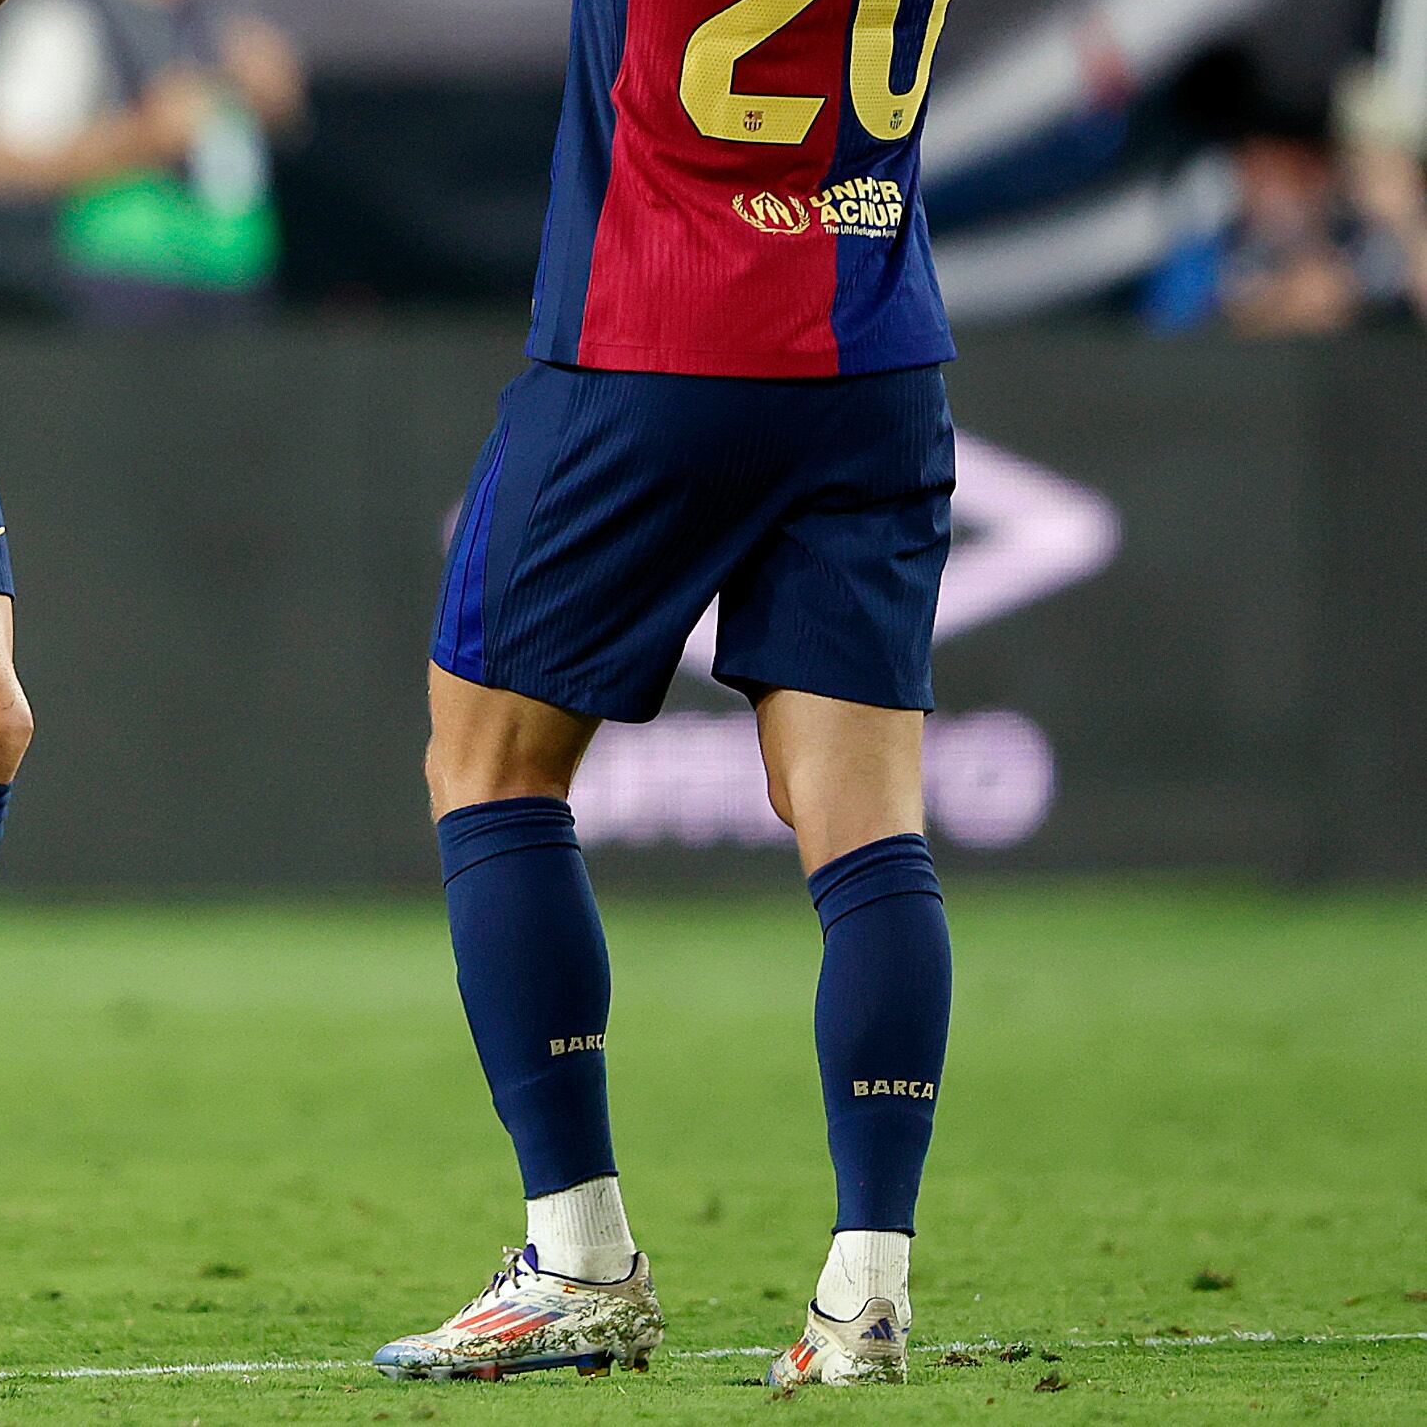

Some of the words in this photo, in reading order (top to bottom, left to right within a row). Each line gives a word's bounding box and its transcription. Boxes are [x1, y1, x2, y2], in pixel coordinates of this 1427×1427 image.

[821, 200, 902, 227] ACNUR
[549, 1034, 605, 1056] BARÇ
[853, 1080, 934, 1100] BARÇA
